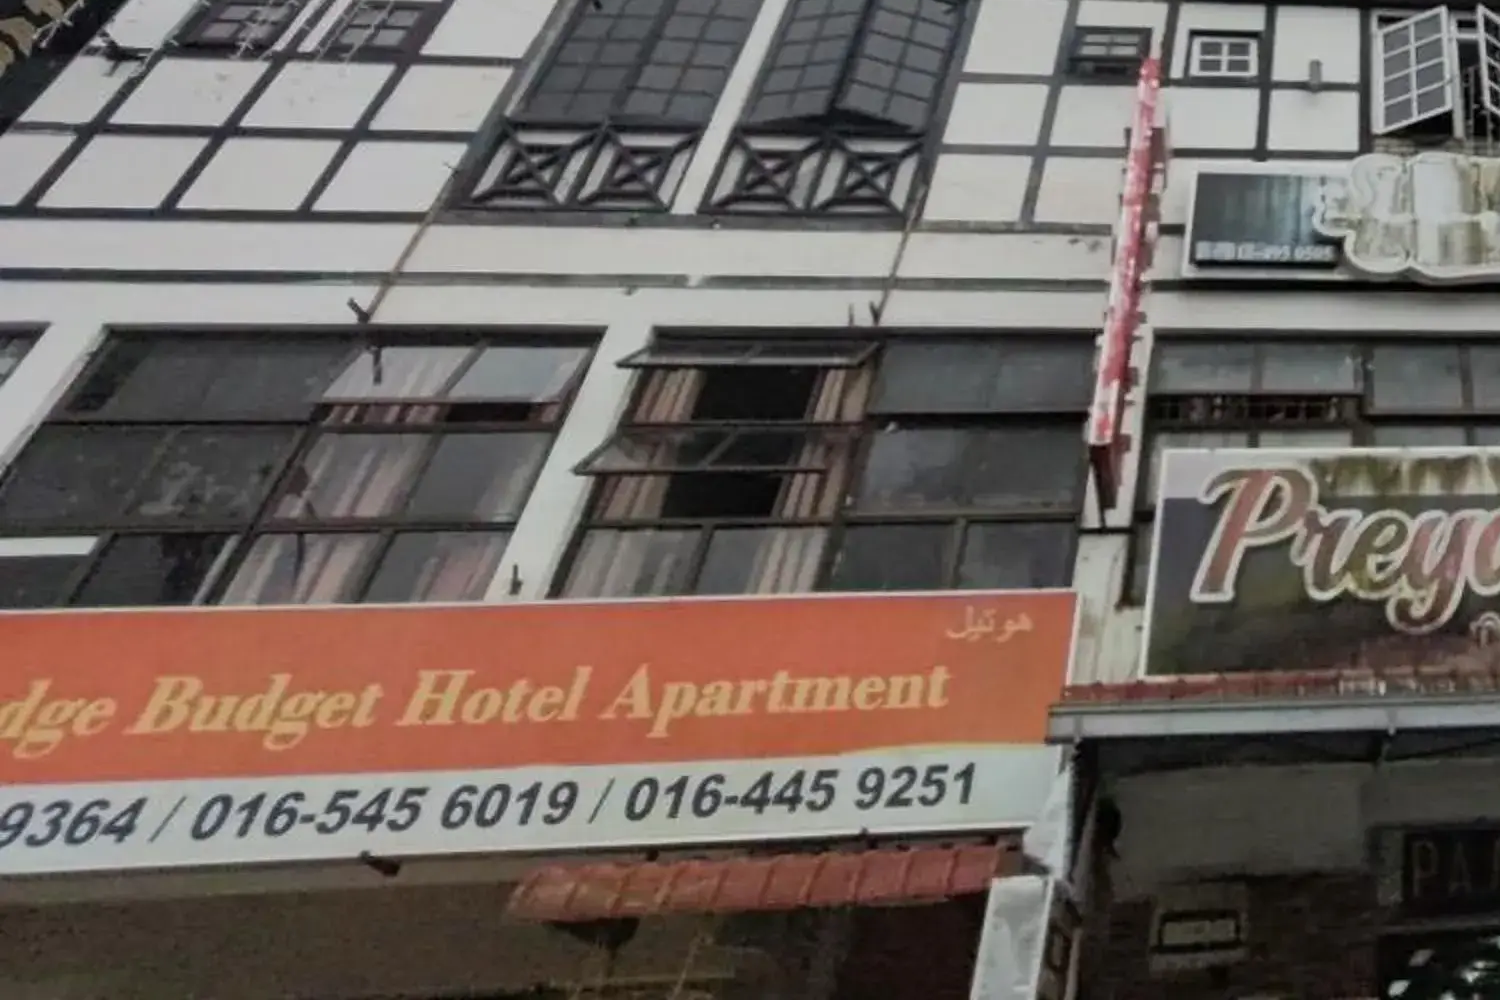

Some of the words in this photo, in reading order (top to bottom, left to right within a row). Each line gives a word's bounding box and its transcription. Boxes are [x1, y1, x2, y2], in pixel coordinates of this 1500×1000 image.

[123, 672, 384, 752] Budget
[394, 664, 594, 727] Hotel
[600, 662, 952, 738] Apartment
[0, 796, 150, 850] 9364
[190, 785, 429, 842] 016-545
[440, 779, 579, 831] 6019
[623, 768, 840, 823] 016-445
[854, 762, 978, 812] 9251
